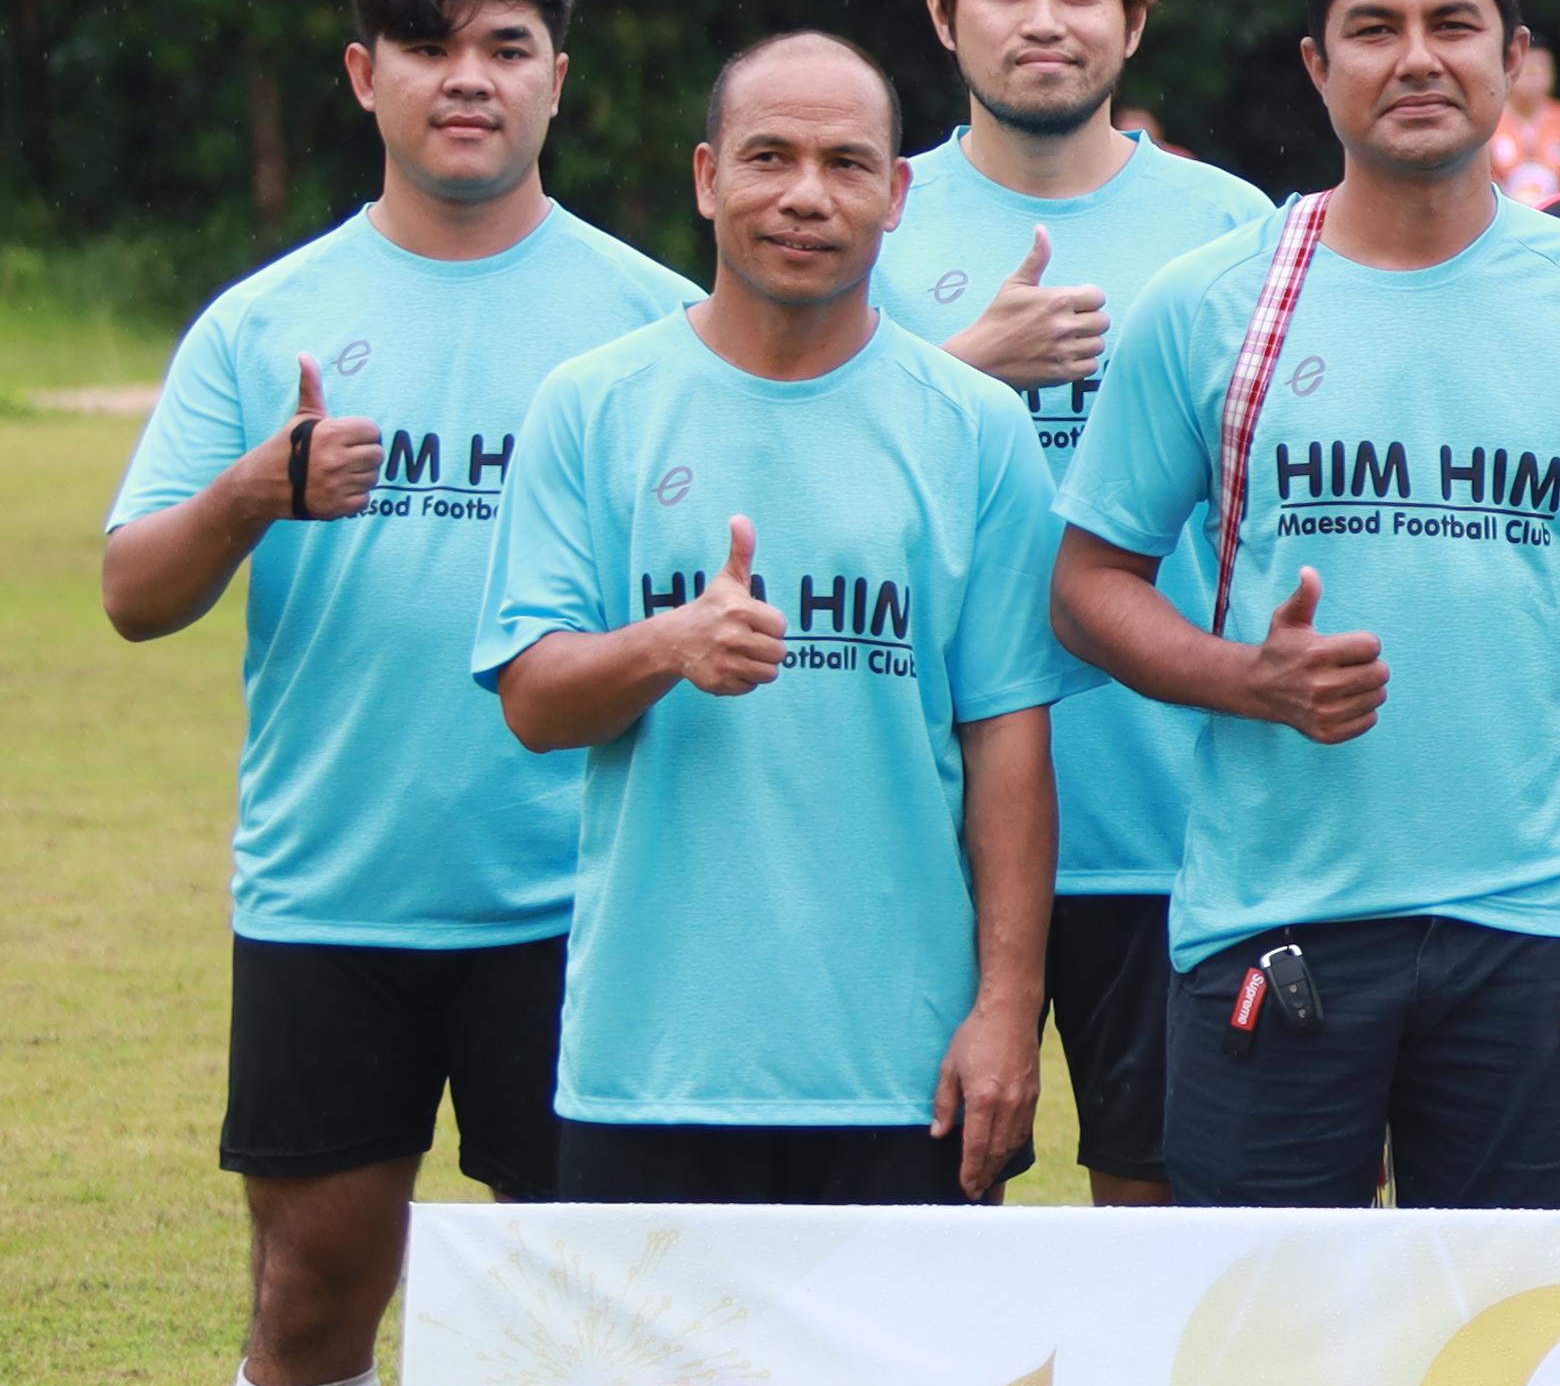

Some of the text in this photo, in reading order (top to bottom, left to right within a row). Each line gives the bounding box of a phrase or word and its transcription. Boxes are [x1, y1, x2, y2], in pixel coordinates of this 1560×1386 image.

[1277, 440, 1411, 500] HIM
[422, 496, 498, 520] Footb
[1278, 510, 1551, 546] Maesod Football Club
[782, 644, 858, 671] otball
[1237, 973, 1265, 1025] Supreme
